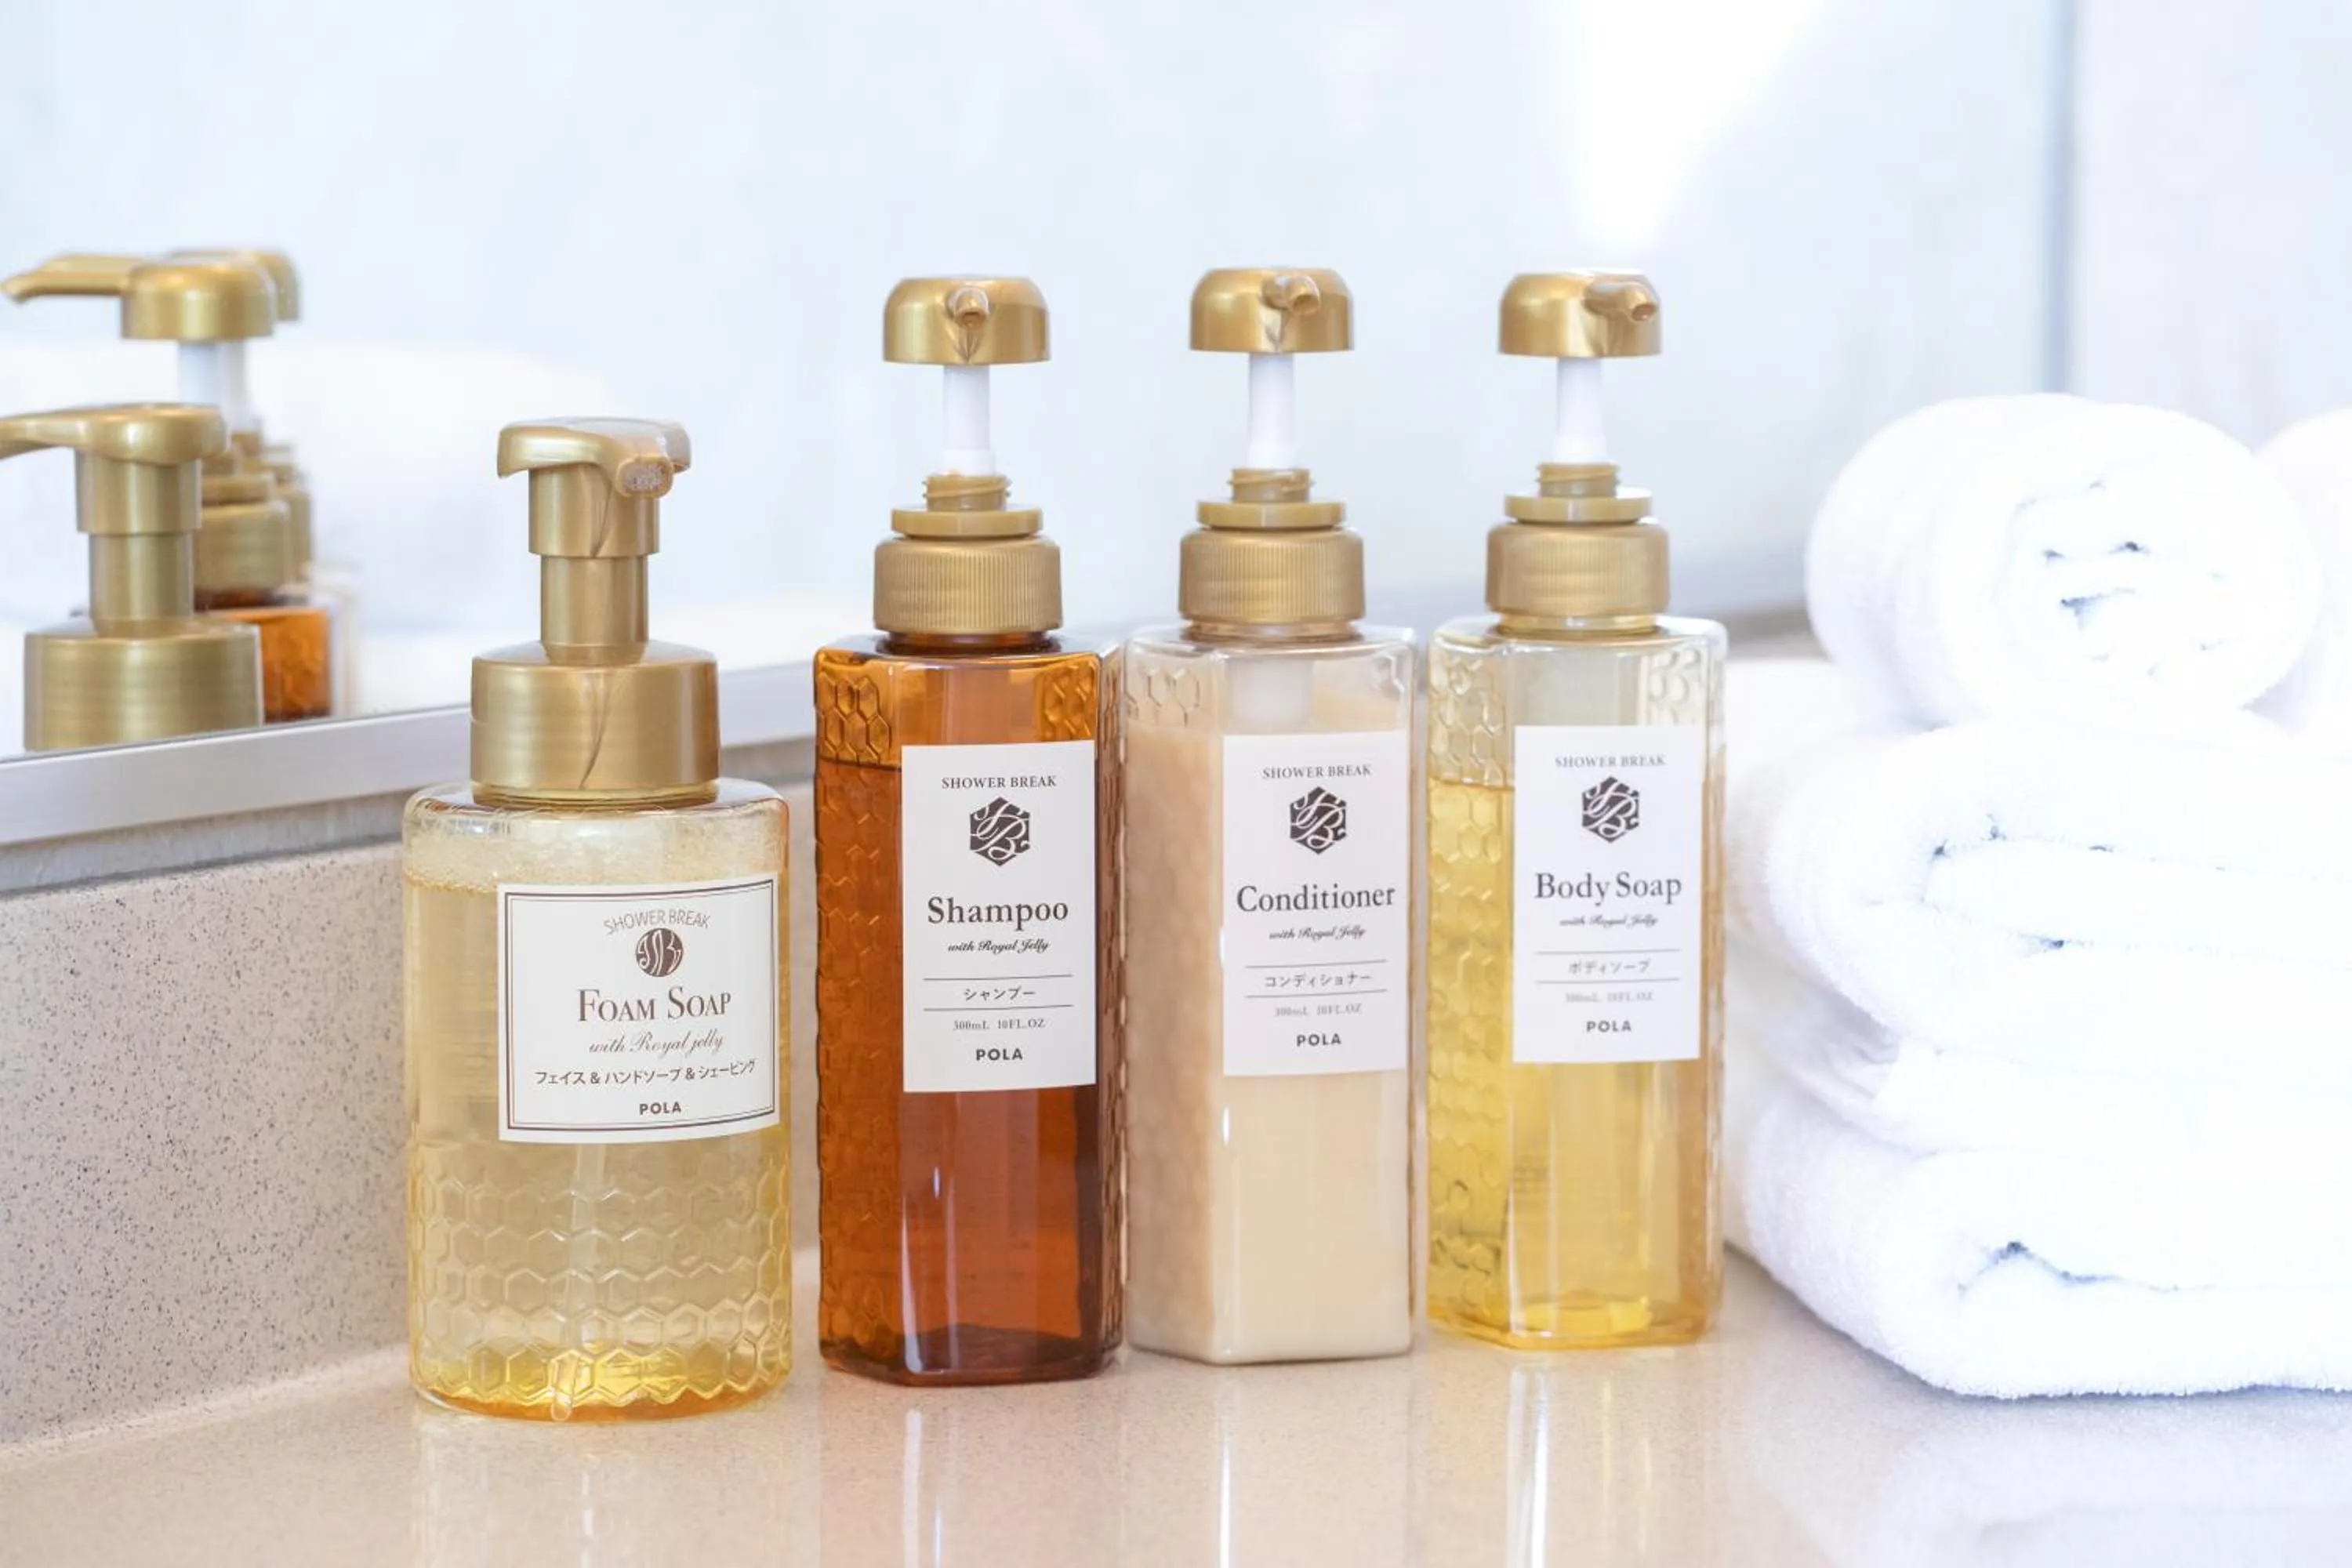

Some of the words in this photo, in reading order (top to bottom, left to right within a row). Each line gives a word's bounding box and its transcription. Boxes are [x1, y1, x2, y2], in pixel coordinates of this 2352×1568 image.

[1555, 756, 1617, 768] SHOWER
[1620, 754, 1665, 768] BREAK
[1262, 766, 1324, 779] SHOWER
[1327, 764, 1373, 778] BREAK
[942, 777, 1006, 789] SHOWER
[1010, 775, 1057, 788] BREAK
[1535, 872, 1610, 907] Body
[1616, 871, 1682, 905] Soap
[1236, 883, 1396, 913] Conditioner
[604, 909, 666, 935] SHOWER
[669, 909, 711, 929] BREAK
[927, 896, 1069, 932] Shampoo
[947, 940, 975, 952] with
[978, 939, 1018, 955] Royal
[1265, 971, 1372, 989] コンディショナー
[964, 985, 1036, 1001] シャンプー
[579, 989, 655, 1022] FOAM
[667, 986, 731, 1020] SOAP
[1586, 1020, 1632, 1033] POLA
[589, 1035, 625, 1053] with
[629, 1030, 691, 1059] Royal
[1296, 1033, 1341, 1047] POLA
[975, 1047, 1023, 1062] POLA
[639, 1101, 682, 1116] POLA
